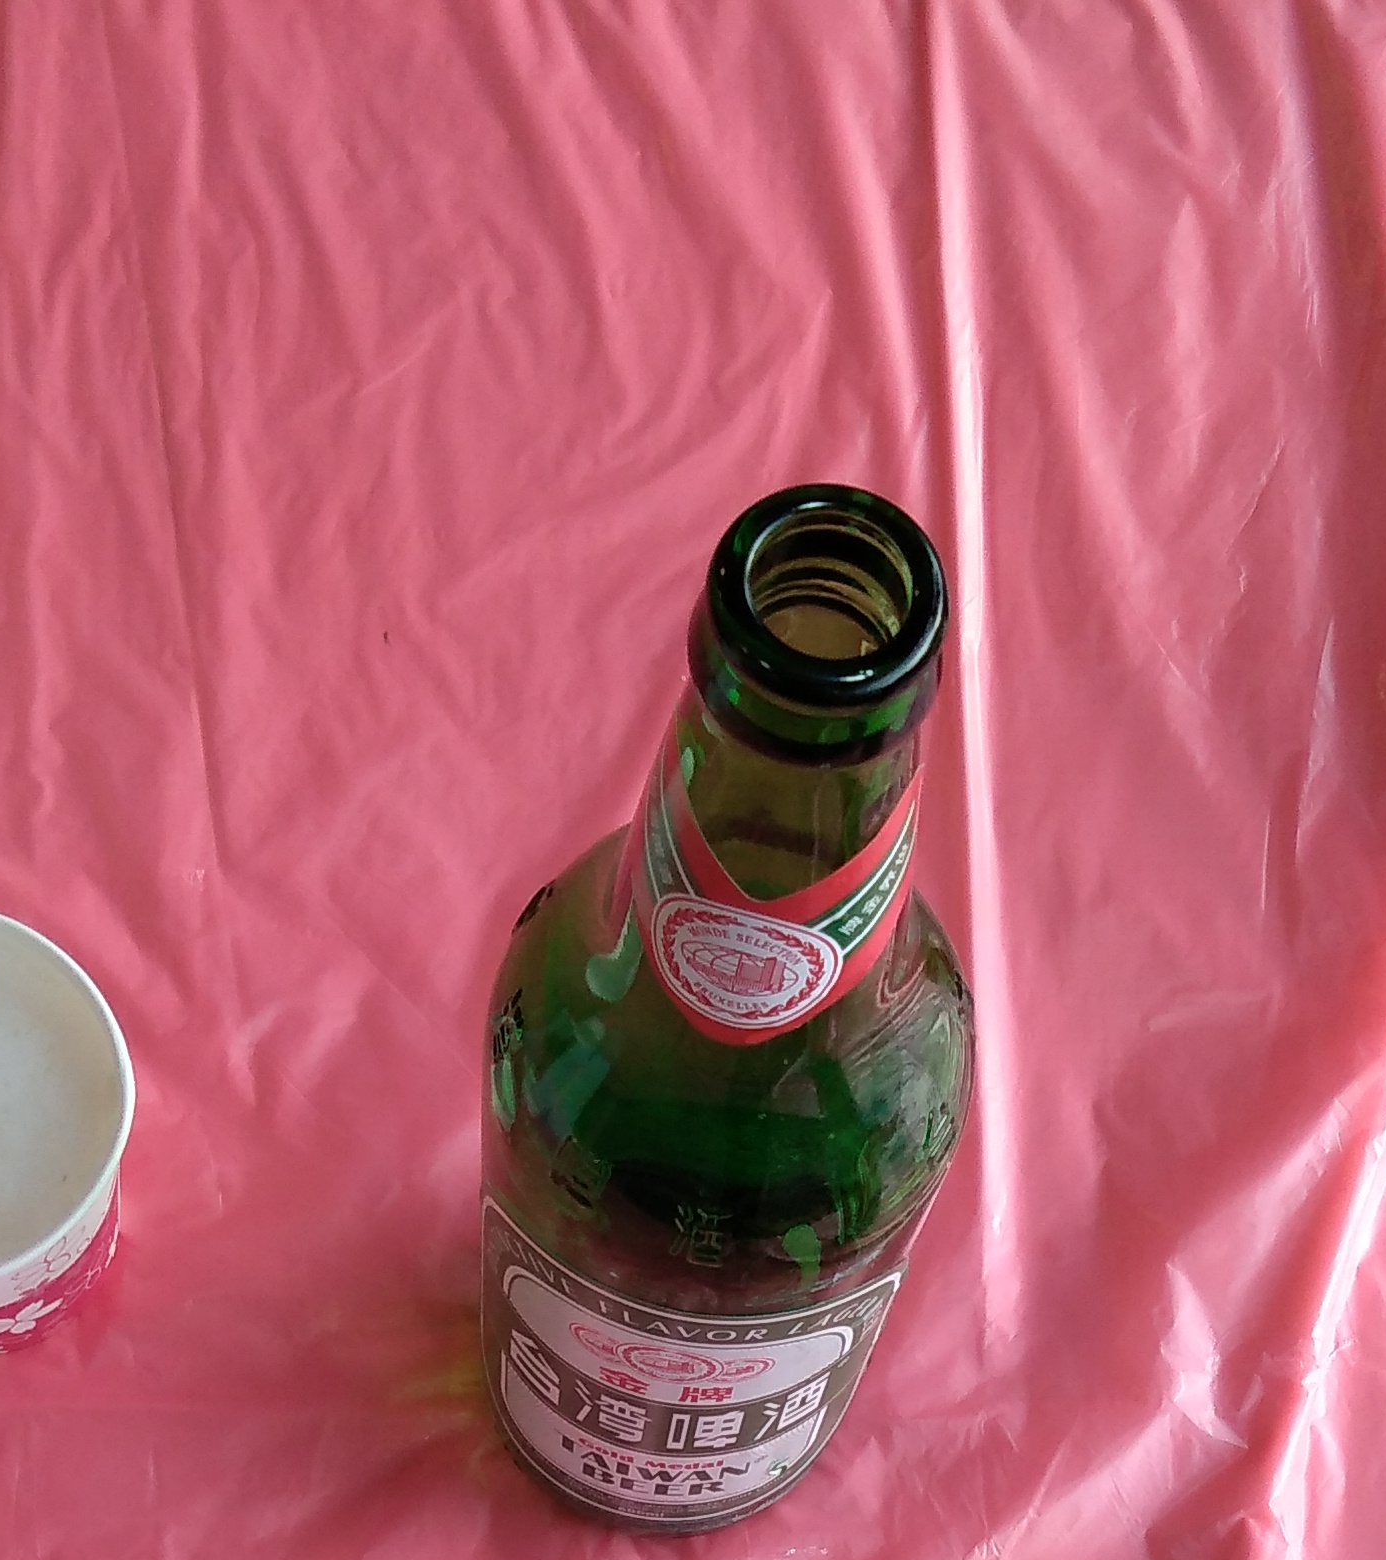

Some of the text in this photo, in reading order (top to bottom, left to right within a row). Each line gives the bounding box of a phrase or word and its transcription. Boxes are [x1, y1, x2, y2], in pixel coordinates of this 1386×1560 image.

[688, 925, 805, 967] MONDE SELECTION
[692, 979, 772, 1012] BRUXELLES
[599, 1301, 768, 1343] FLAVOR
[598, 1366, 735, 1405] 金牌
[554, 1428, 750, 1483] TAIWAN
[578, 1437, 726, 1470] Gold Medal
[581, 1464, 727, 1497] BEER
